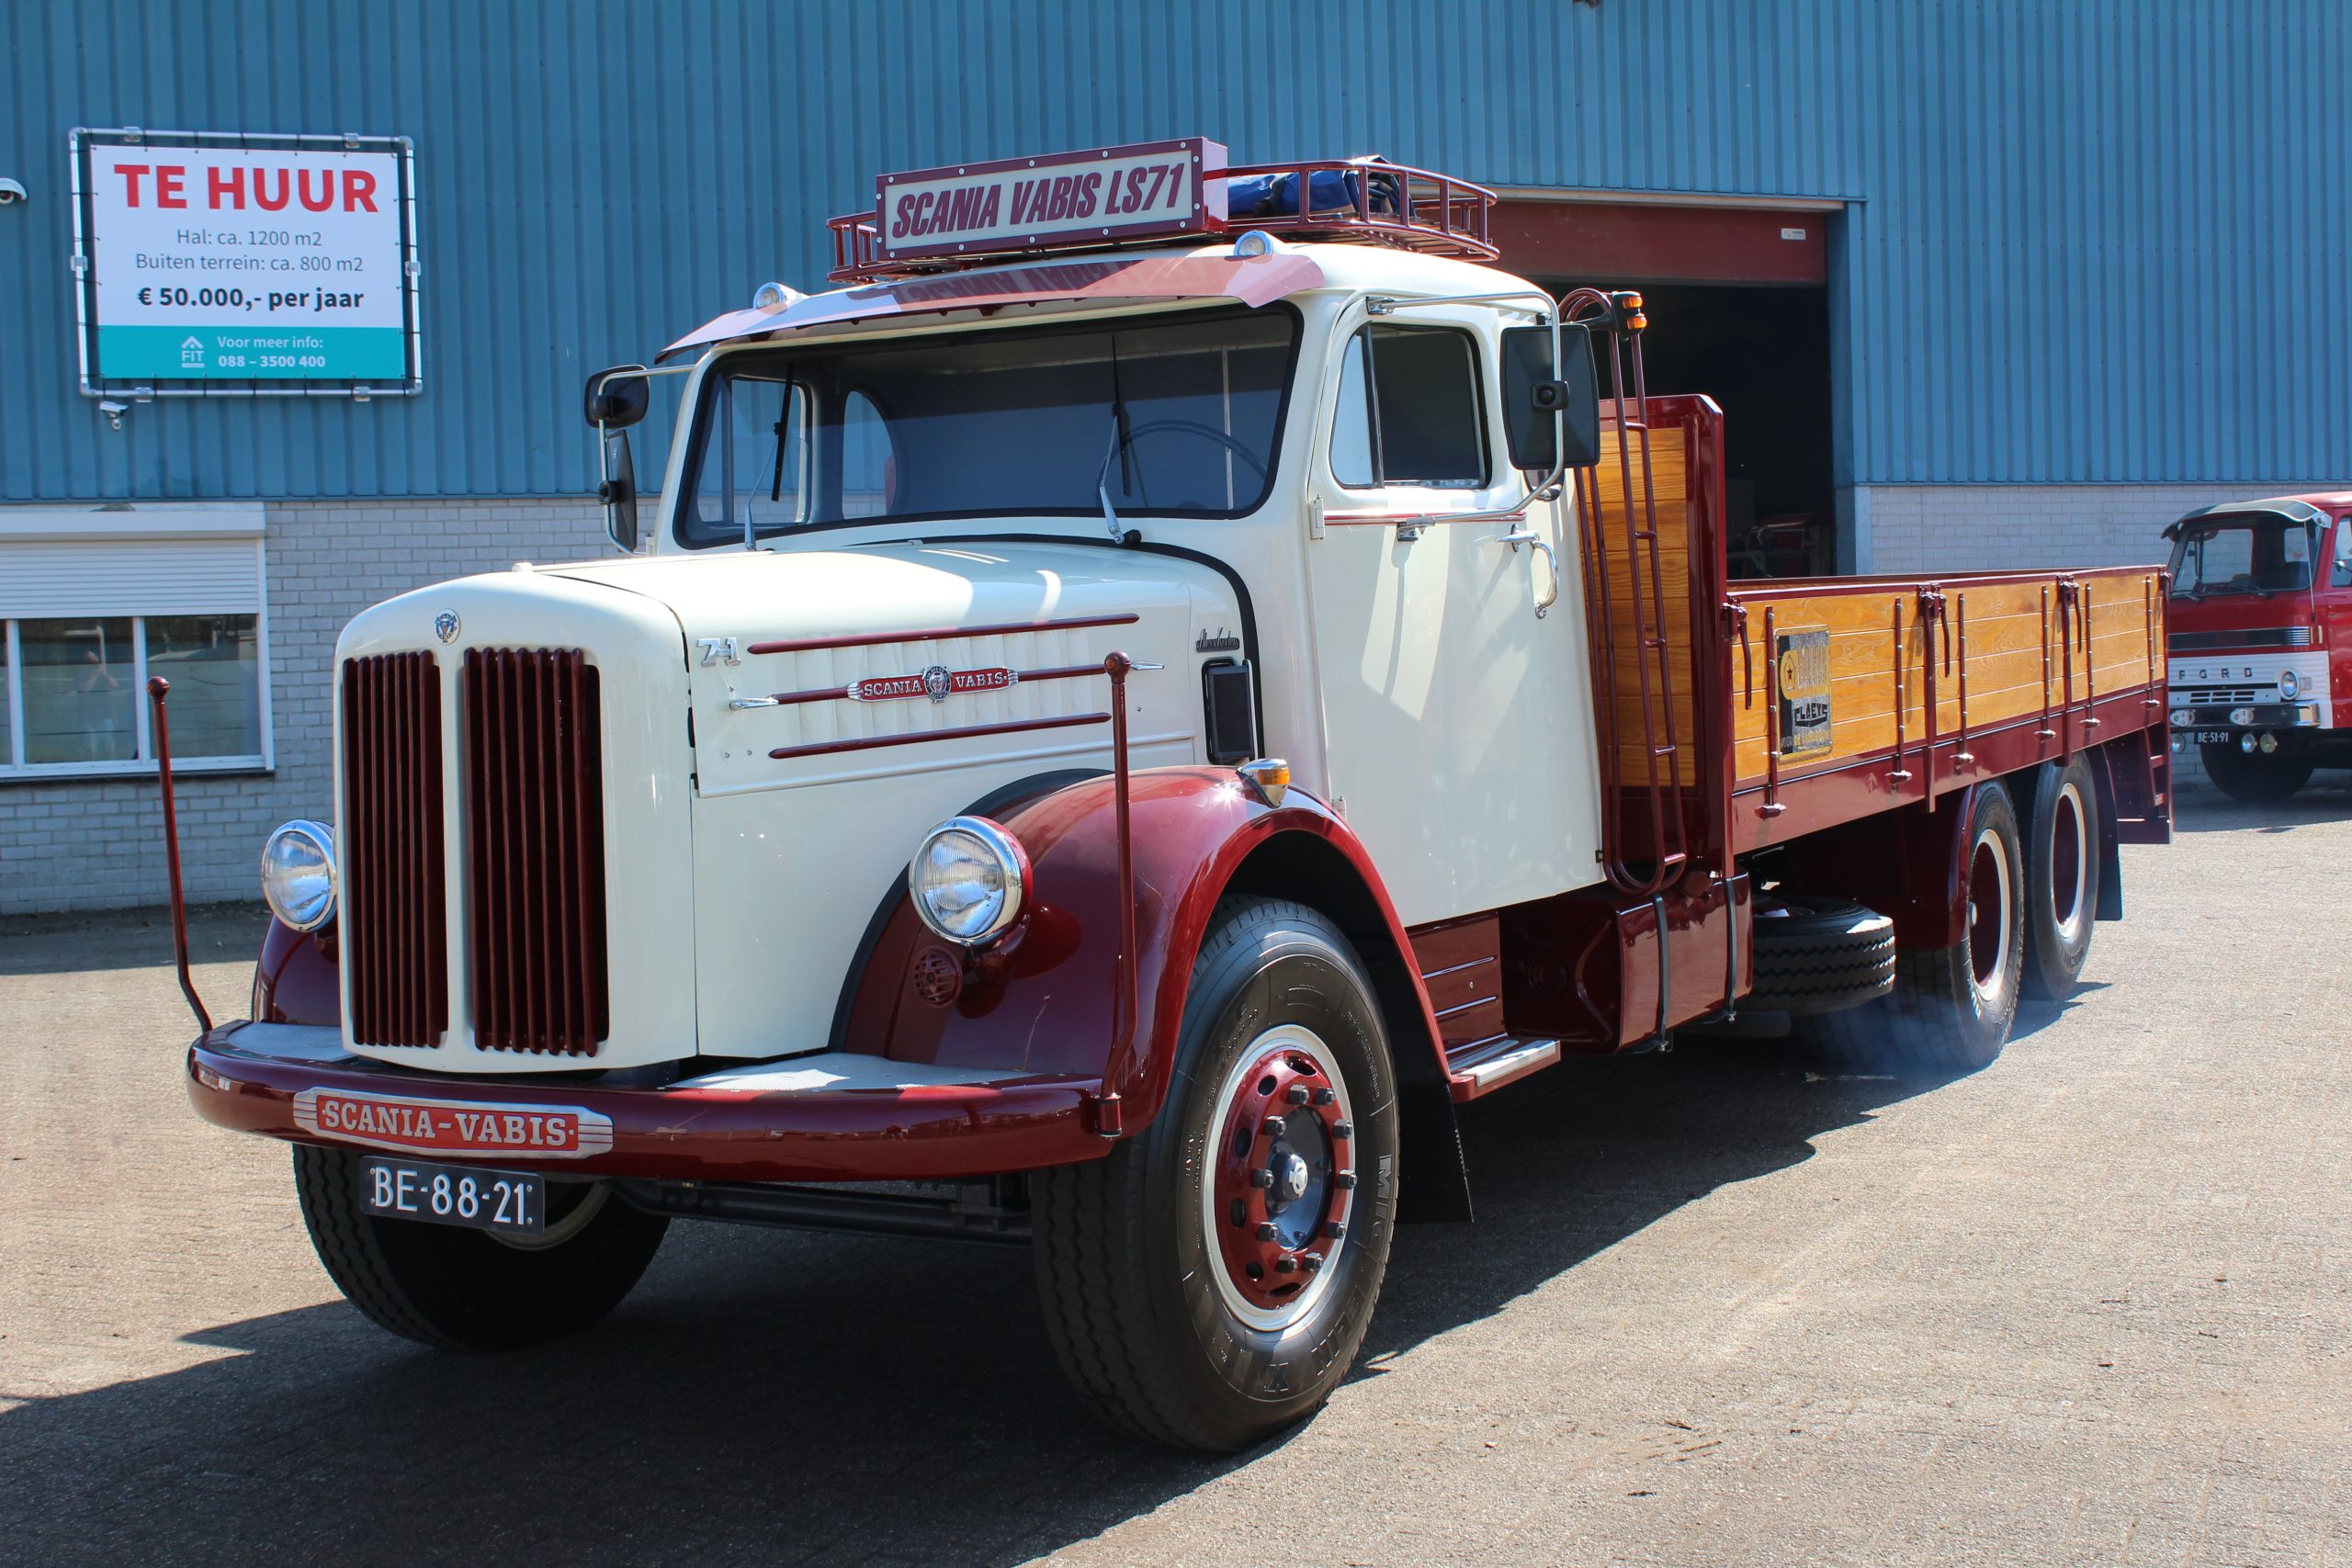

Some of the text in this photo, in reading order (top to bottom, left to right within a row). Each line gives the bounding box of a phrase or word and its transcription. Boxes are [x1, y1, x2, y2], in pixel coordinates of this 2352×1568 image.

[114, 164, 379, 212] TE HUUR
[891, 163, 1185, 239] SCANIA VABIS LS71
[176, 229, 322, 247] Hal: ca. 1200 m2
[136, 253, 364, 272] Buiten terrein: ca. 800 m2
[138, 287, 365, 312] € 50.000,- per jaar
[217, 336, 323, 349] Voor meer info:
[181, 350, 205, 362] FIT
[218, 355, 245, 367] 088
[259, 355, 296, 367] 3500
[298, 355, 325, 367] 400
[2177, 667, 2254, 680] FORD
[864, 679, 923, 697] SCANIA
[955, 671, 1003, 689] VABIS
[2197, 732, 2229, 743] BE-51-91
[374, 1165, 525, 1225] BE-88-21
